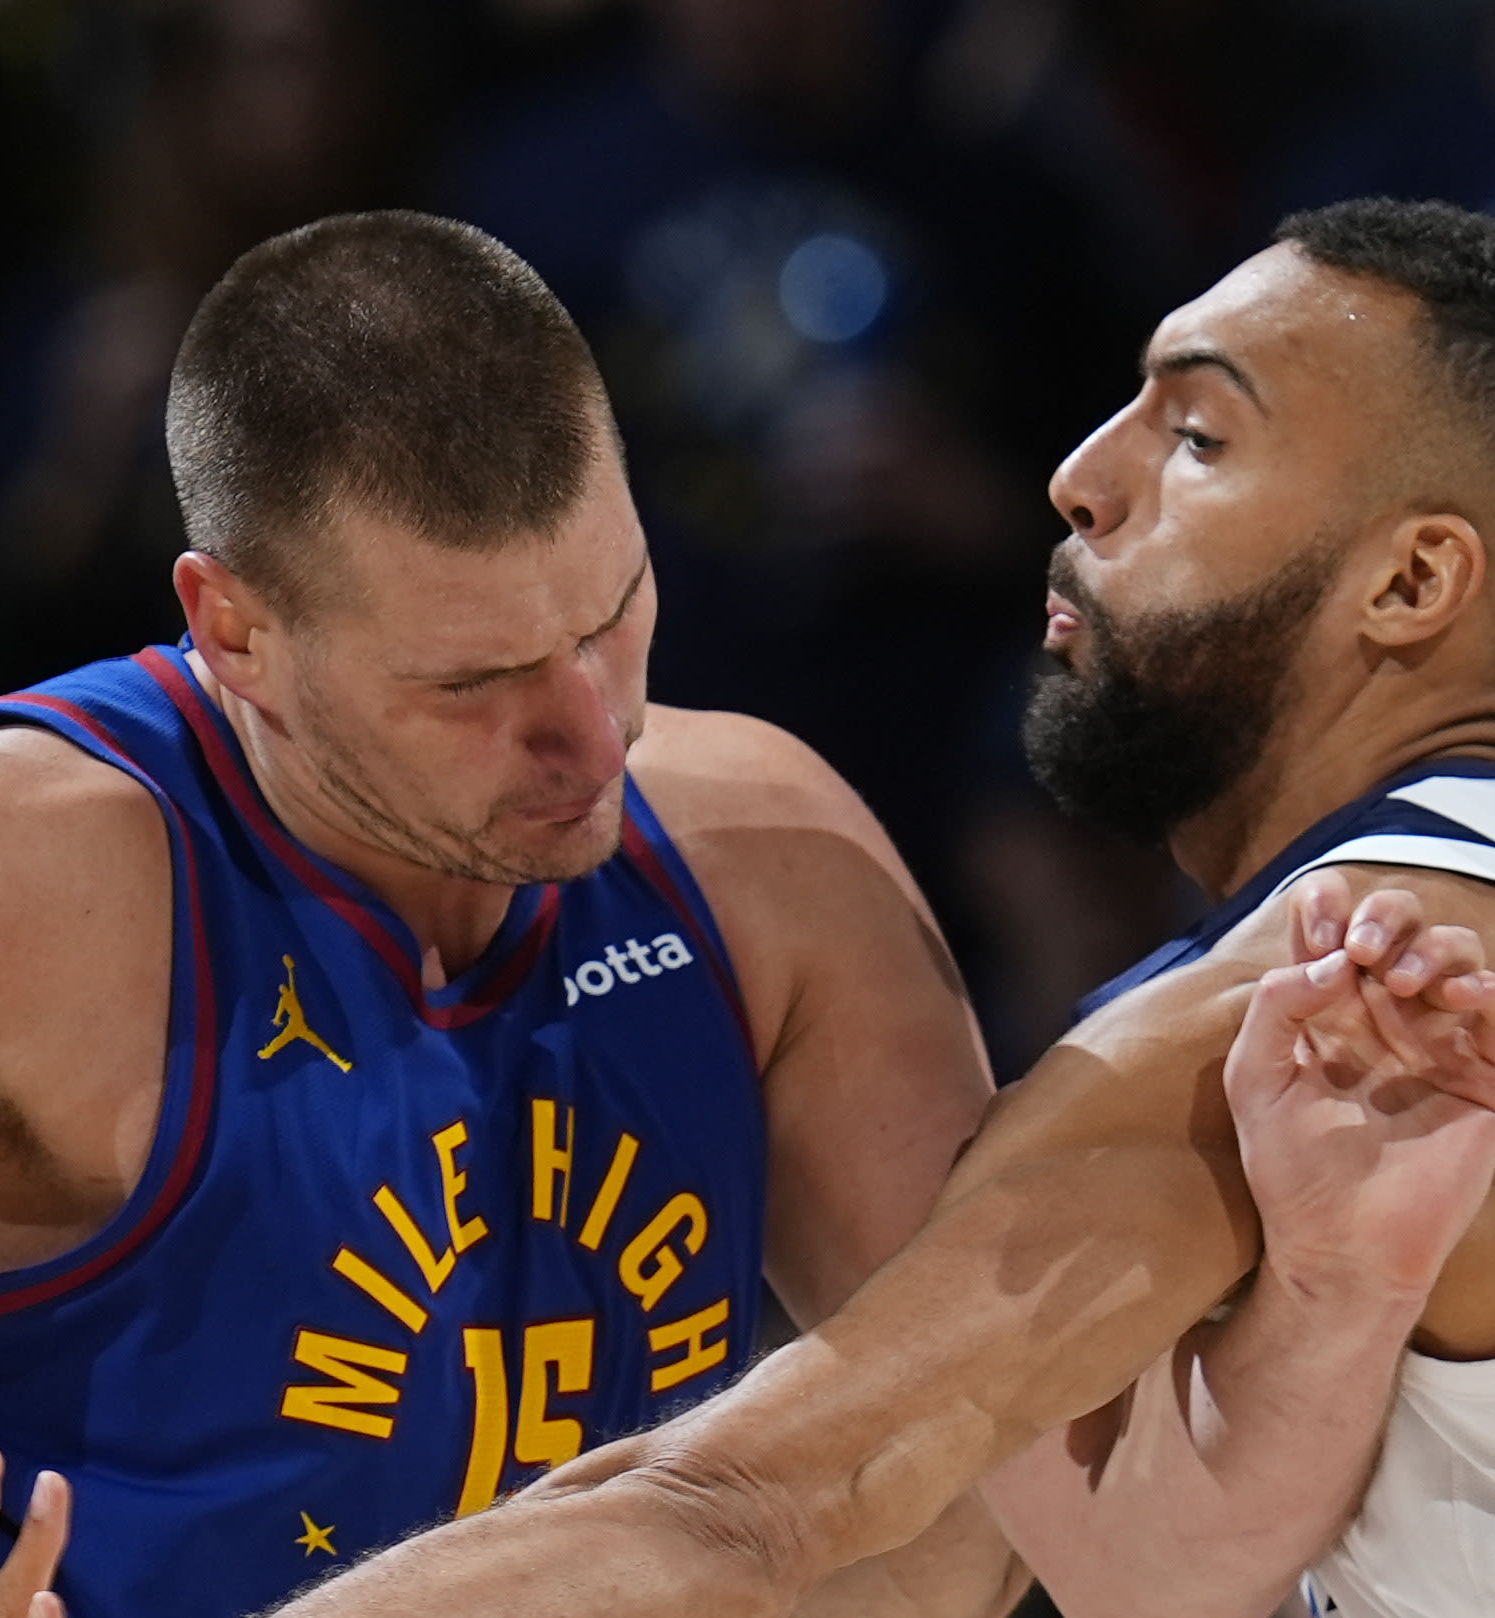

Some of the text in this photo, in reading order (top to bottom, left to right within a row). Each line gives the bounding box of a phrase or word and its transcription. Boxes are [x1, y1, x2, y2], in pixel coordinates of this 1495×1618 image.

[279, 1099, 730, 1440] MILE HIGH
[454, 1318, 595, 1521] 15
